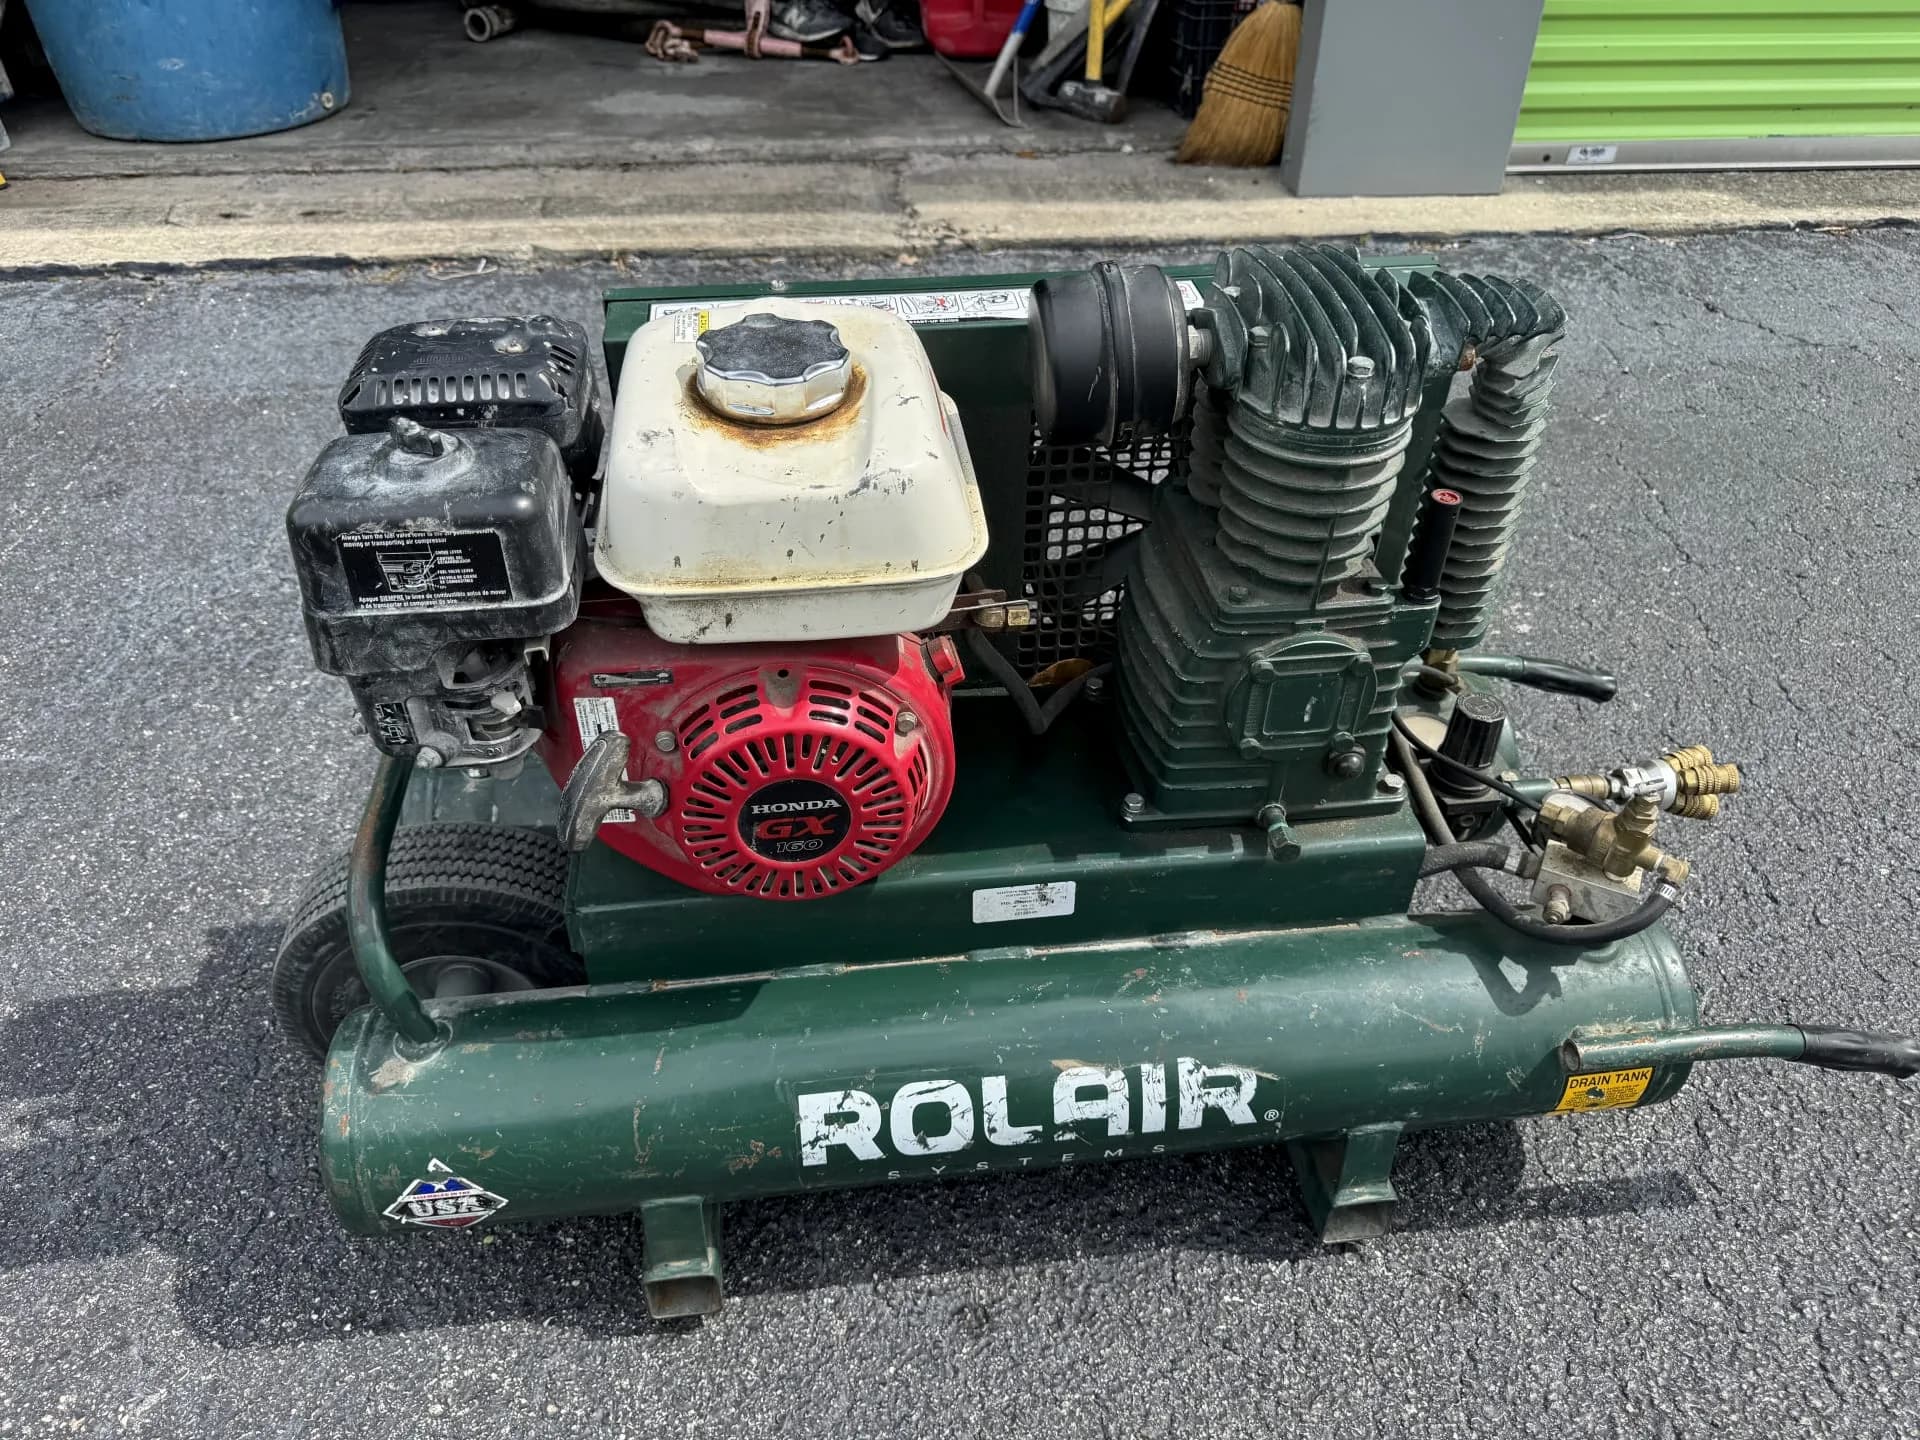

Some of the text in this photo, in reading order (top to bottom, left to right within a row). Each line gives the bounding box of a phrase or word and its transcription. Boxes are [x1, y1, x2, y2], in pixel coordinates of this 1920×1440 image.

[371, 538, 405, 547] transporting
[750, 799, 842, 815] HONDA
[755, 814, 839, 839] GX
[776, 838, 824, 853] 160
[1569, 1069, 1651, 1090] DRAIN TANK
[797, 1055, 1258, 1168] ROLAIR
[887, 1143, 1167, 1181] SYSTEMS
